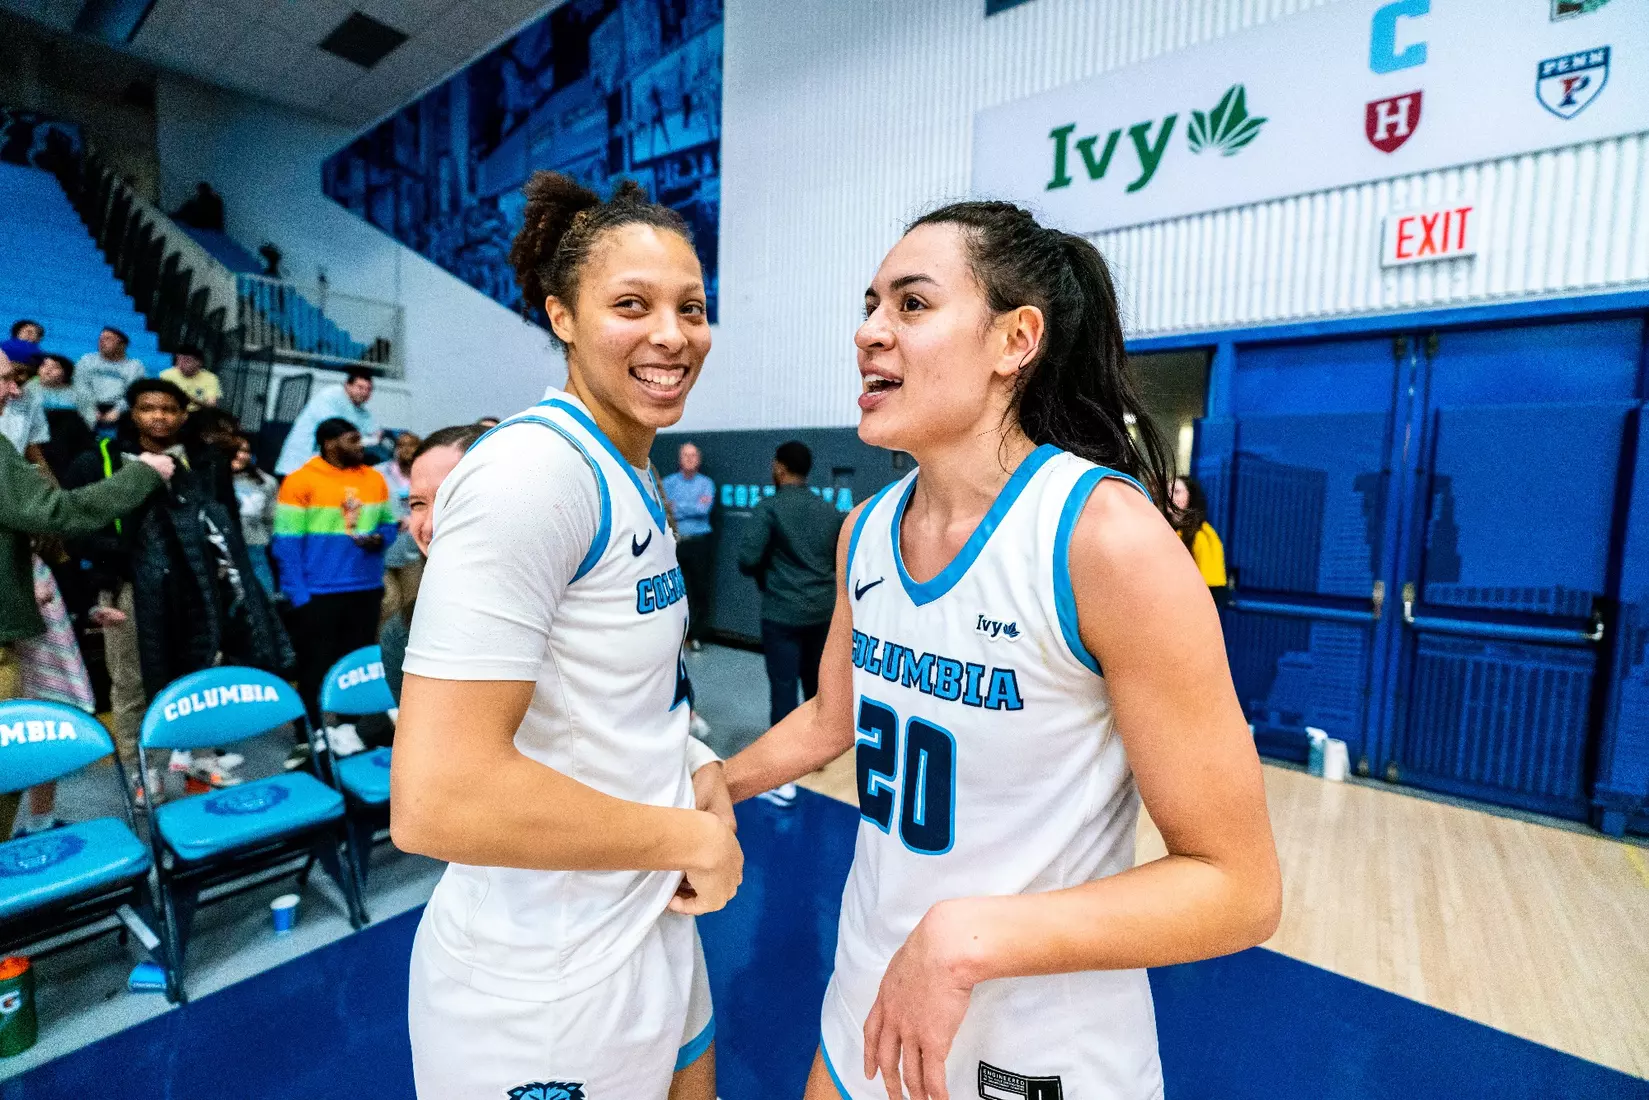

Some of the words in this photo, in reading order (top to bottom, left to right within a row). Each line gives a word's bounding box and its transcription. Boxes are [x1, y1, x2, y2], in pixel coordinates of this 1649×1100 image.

[1369, 0, 1432, 75] C
[1558, 75, 1591, 108] P
[1373, 96, 1412, 142] H
[1045, 112, 1179, 194] Ivy
[1395, 206, 1473, 260] EXIT
[975, 613, 1003, 638] Ivy
[851, 628, 1024, 711] OLUMBIA
[163, 684, 280, 722] COLUMBIA
[855, 693, 959, 857] 20
